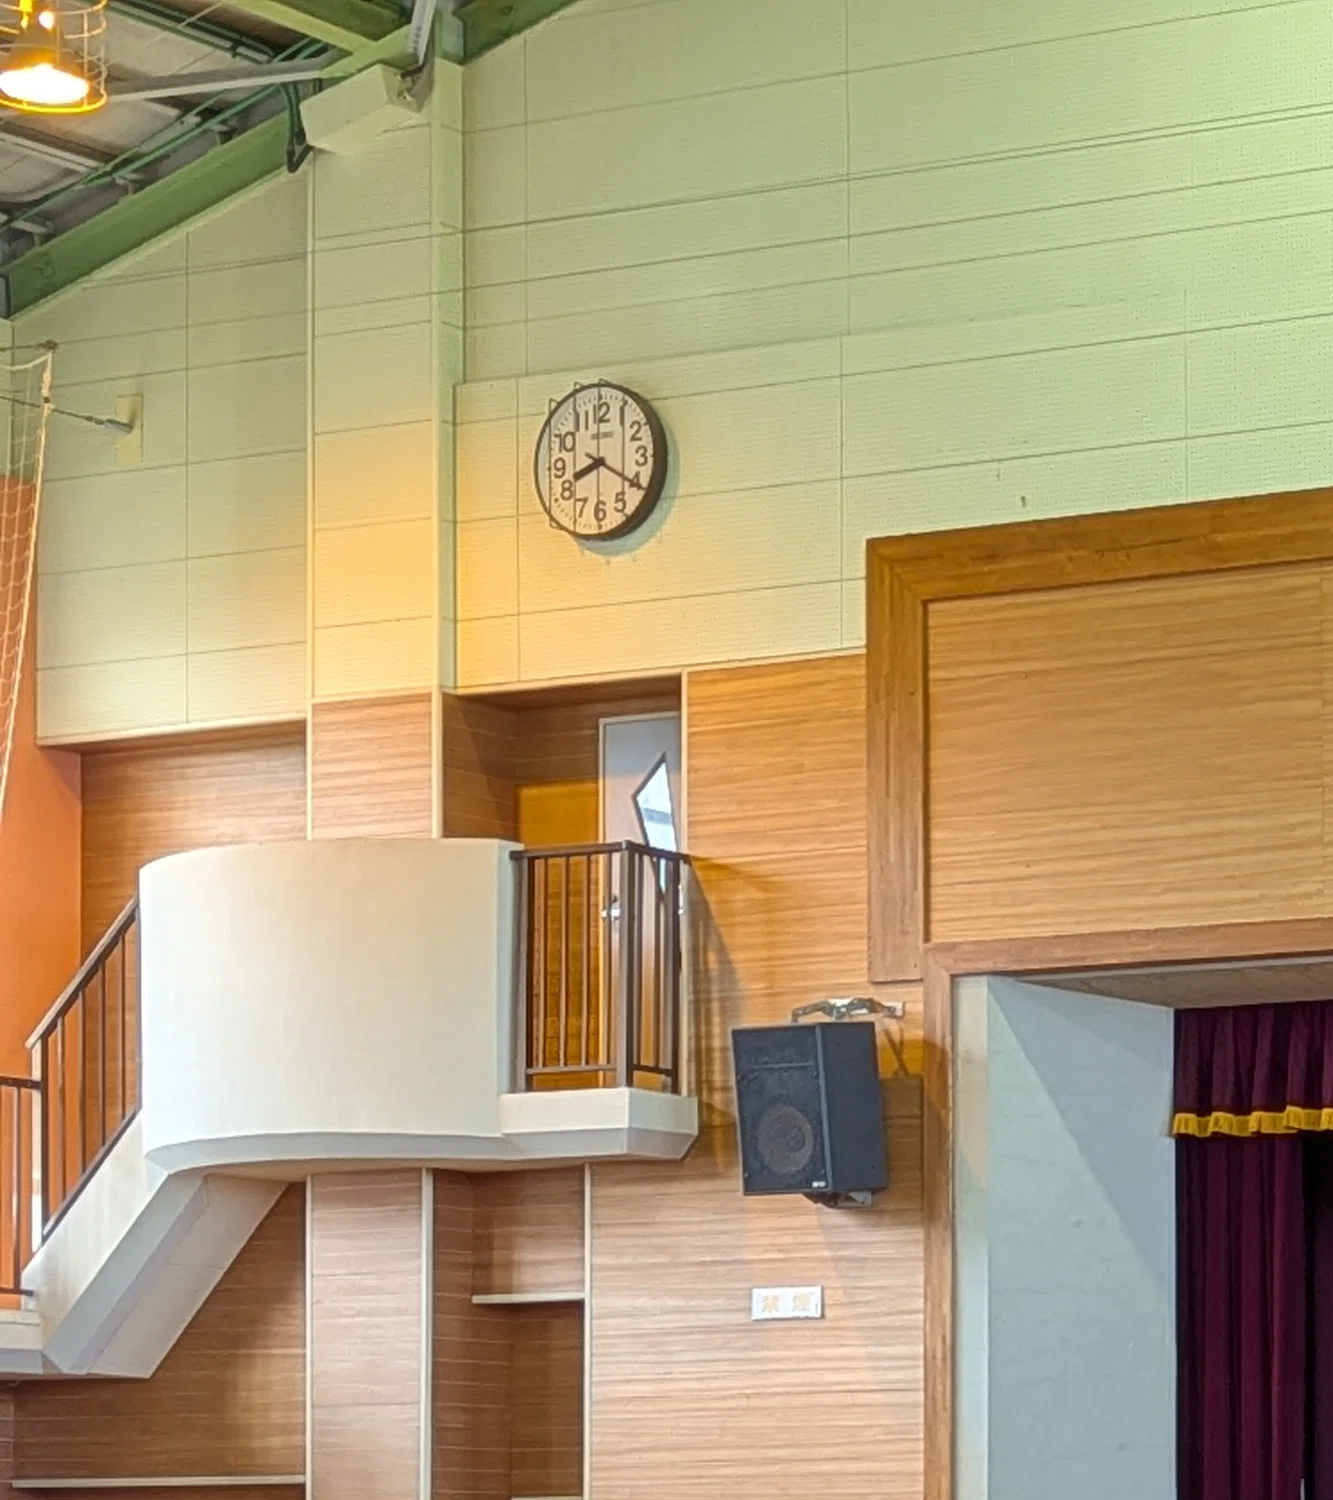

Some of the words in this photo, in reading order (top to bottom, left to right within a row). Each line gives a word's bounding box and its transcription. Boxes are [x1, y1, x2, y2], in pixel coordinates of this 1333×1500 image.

[574, 410, 589, 432] 11
[593, 402, 610, 424] 12
[554, 431, 576, 453] 10
[629, 420, 642, 442] 2
[634, 445, 648, 467] 3
[553, 457, 566, 479] 9
[560, 479, 573, 501] 8
[628, 471, 643, 491] 4
[575, 497, 589, 518] 7
[594, 500, 607, 522] 6
[613, 491, 627, 513] 5
